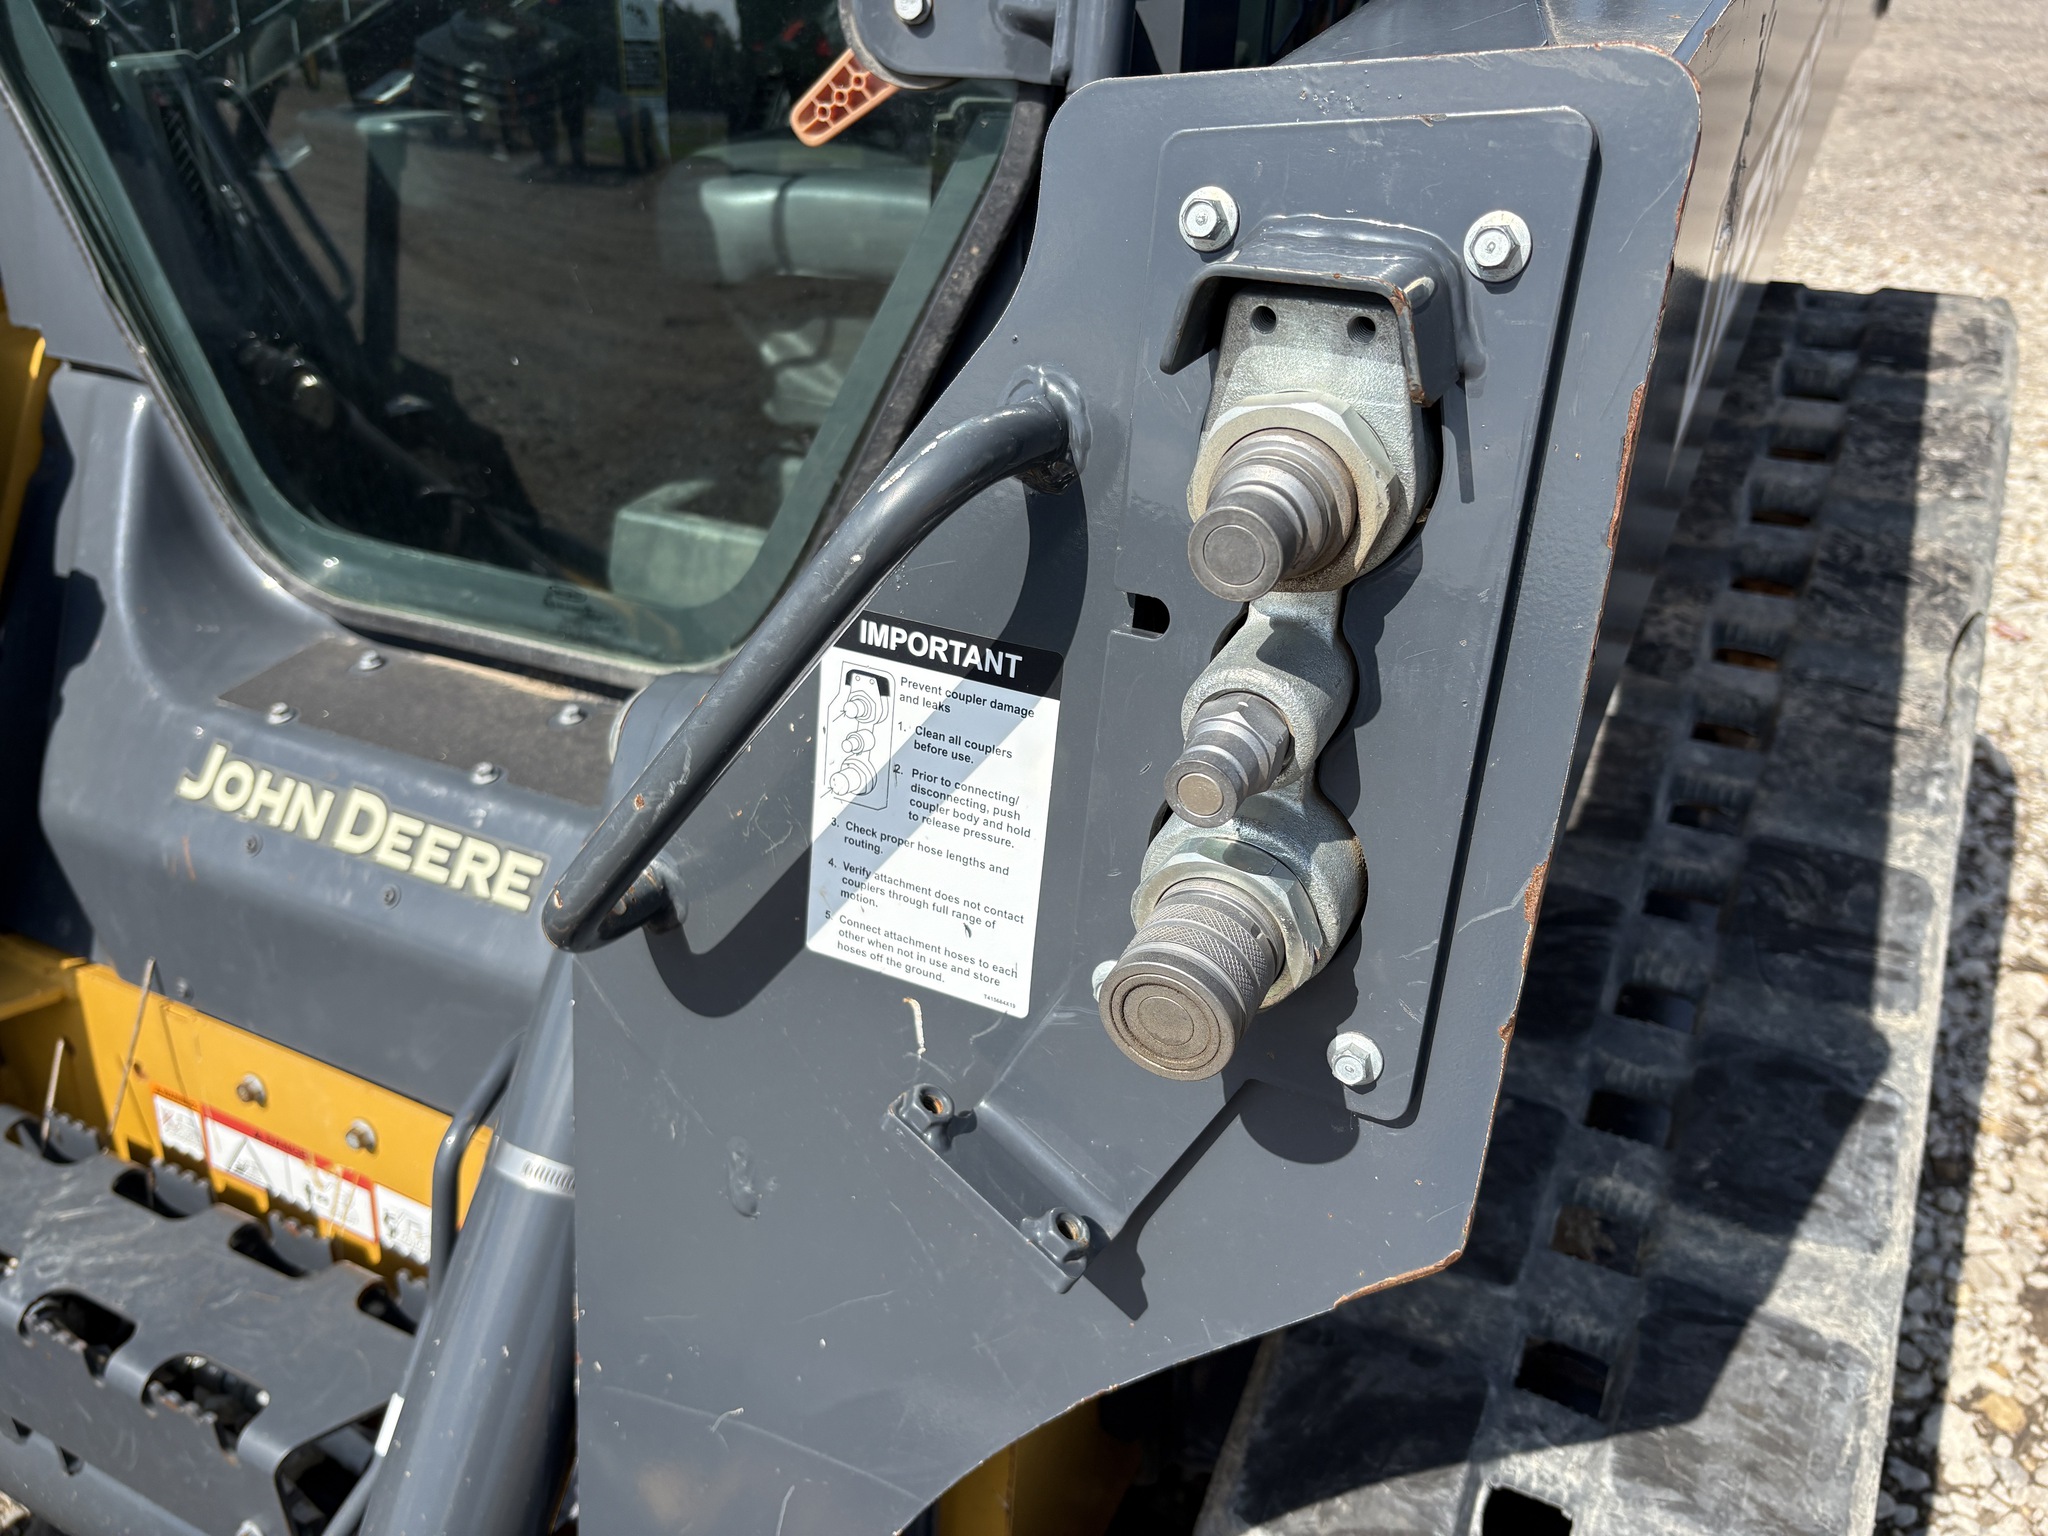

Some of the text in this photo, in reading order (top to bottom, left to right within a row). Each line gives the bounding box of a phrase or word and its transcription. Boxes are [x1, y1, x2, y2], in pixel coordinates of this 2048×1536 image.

[860, 619, 1023, 678] IMPORTANT
[899, 694, 951, 713] and leaks
[900, 676, 1034, 718] Prevent coupler damage
[897, 721, 1012, 759] 1. Clean all couplers
[914, 739, 974, 764] before use.
[893, 764, 1020, 806] 2. Prior to connecting/
[910, 783, 1020, 821] disconnecting, push
[176, 743, 544, 912] JOHN DEERE
[908, 811, 1014, 848] to release pressure.
[909, 798, 1031, 838] coupler body and hold
[831, 817, 1009, 876] 3. Check proper hose lengths and
[844, 836, 883, 855] routing.
[828, 858, 1024, 924] 4. Verify attachment does not contact
[840, 890, 878, 908] motion.
[842, 877, 996, 929] couplers through full range of
[837, 940, 945, 983] hoses off the ground.
[838, 929, 1000, 986] other when not in use and store
[839, 914, 881, 935] Connect
[884, 930, 941, 954] attachment
[944, 947, 975, 965] hoses
[979, 959, 989, 969] to
[992, 964, 1017, 978] each
